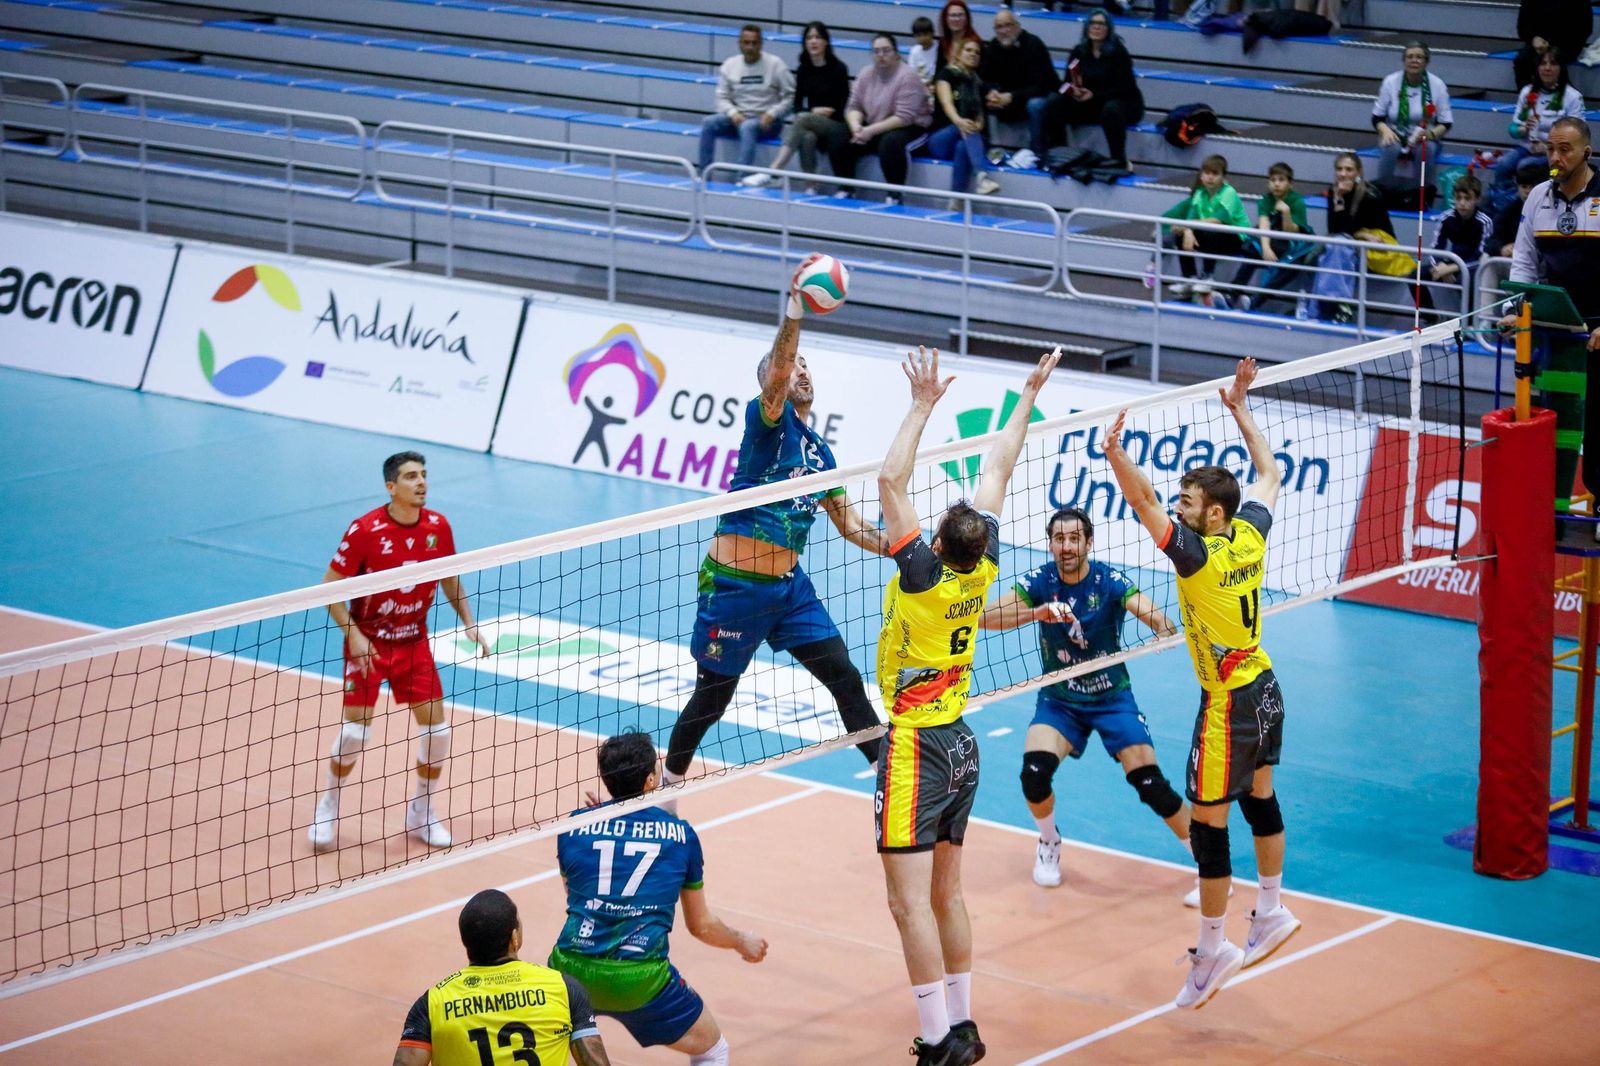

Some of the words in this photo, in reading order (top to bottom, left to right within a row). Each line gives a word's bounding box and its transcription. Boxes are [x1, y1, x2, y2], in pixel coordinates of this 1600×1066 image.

[312, 288, 476, 363] Andalucía
[670, 389, 751, 429] COS
[616, 433, 740, 490] ALME
[1397, 566, 1480, 597] SUPERLI
[1239, 587, 1259, 639] 4
[950, 625, 973, 656] 6
[875, 790, 884, 814] 6
[631, 821, 686, 844] RENAN
[592, 840, 662, 897] 17
[444, 988, 546, 1020] PERNAMBUCO
[467, 1021, 542, 1066] 13
